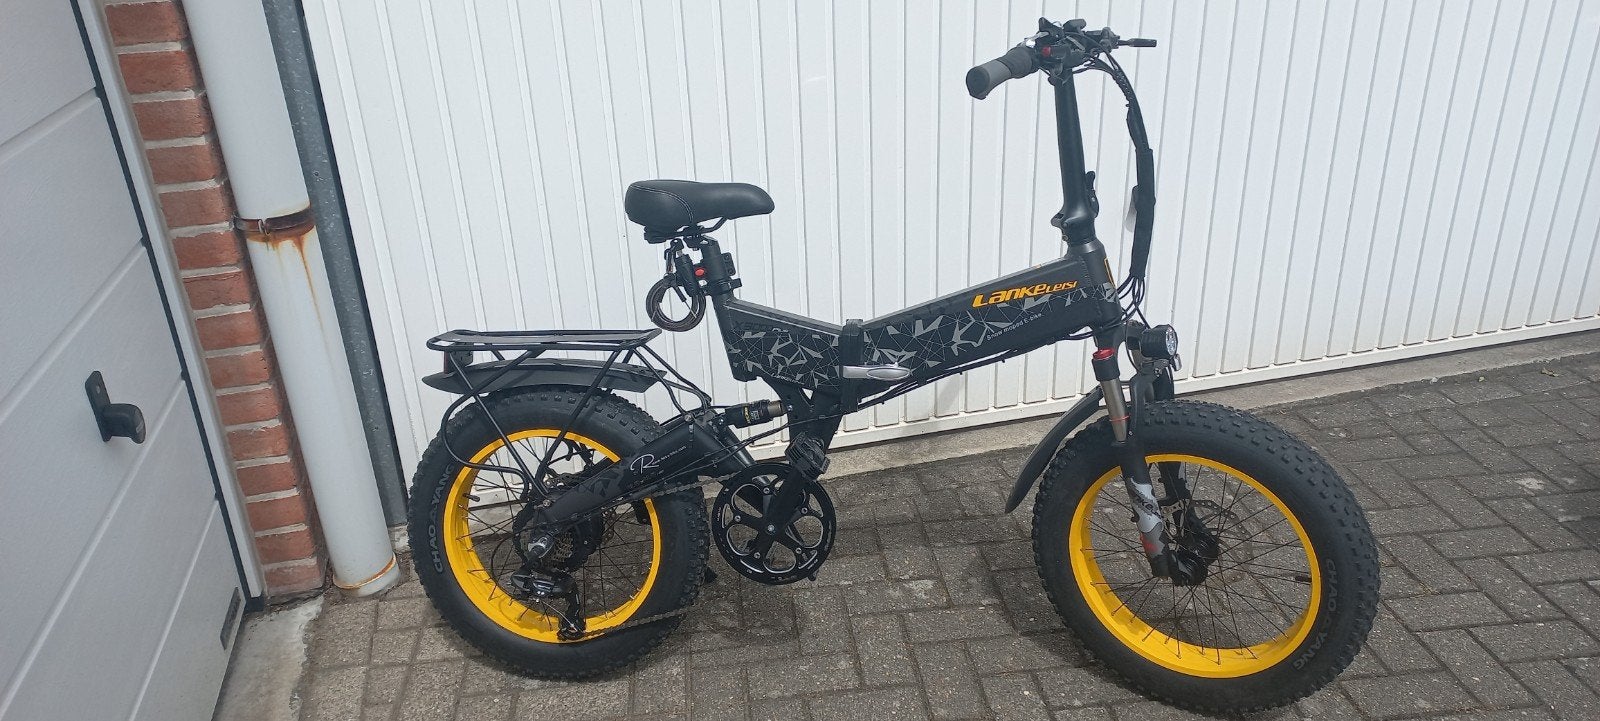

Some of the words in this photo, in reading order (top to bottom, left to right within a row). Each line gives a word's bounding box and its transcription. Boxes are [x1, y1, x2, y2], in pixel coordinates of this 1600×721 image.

[431, 463, 455, 505] YANG
[428, 524, 444, 573] CHAO
[1326, 558, 1339, 612] CHAO
[1293, 631, 1329, 670] YANG
